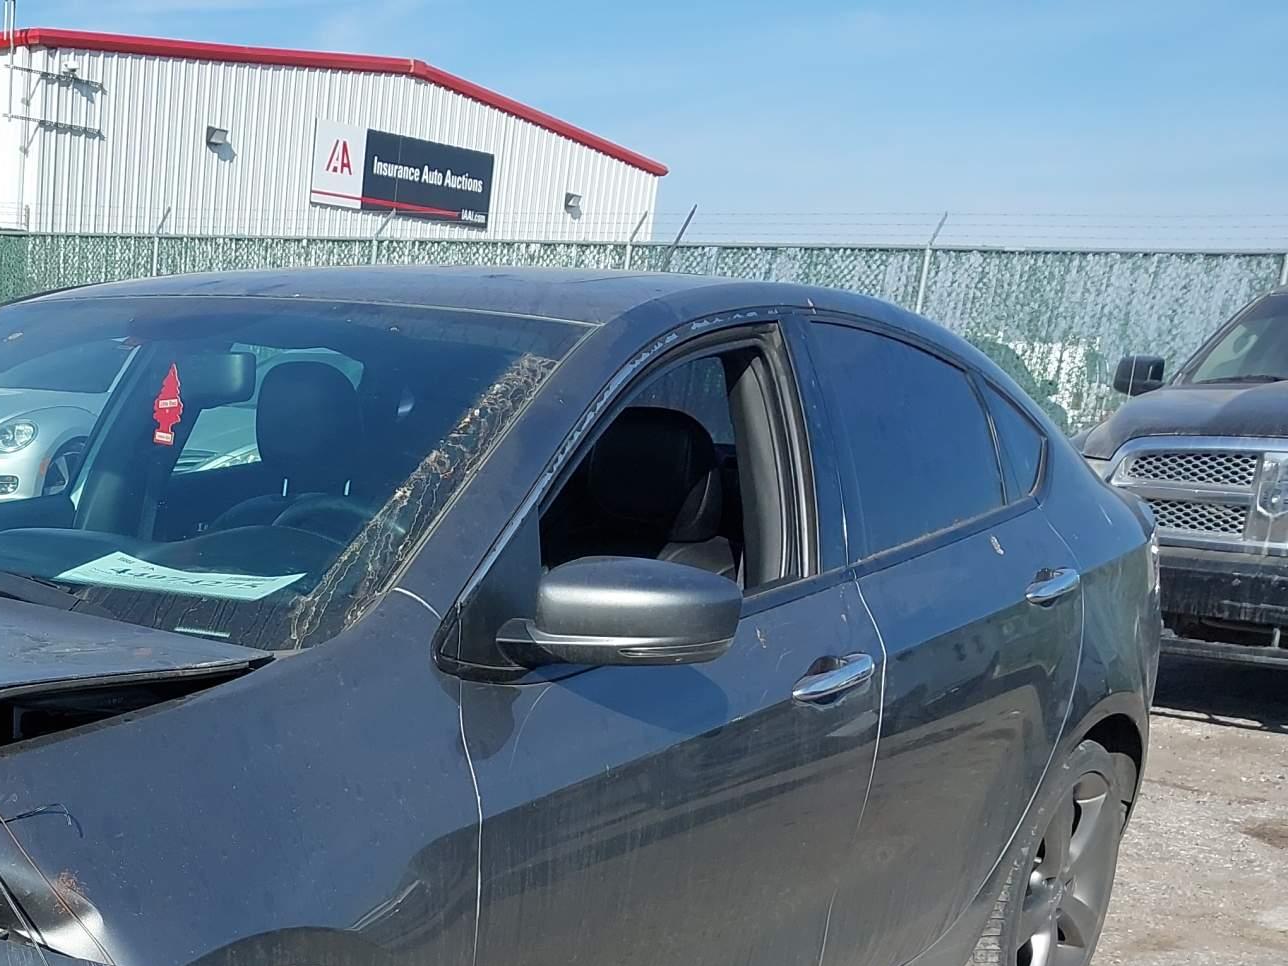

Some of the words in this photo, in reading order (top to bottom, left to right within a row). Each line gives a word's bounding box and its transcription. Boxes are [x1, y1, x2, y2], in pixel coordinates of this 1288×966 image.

[373, 155, 420, 182] Insurance
[421, 165, 443, 186] Auto
[443, 169, 484, 193] Auctions
[461, 208, 486, 224] IAAI.com
